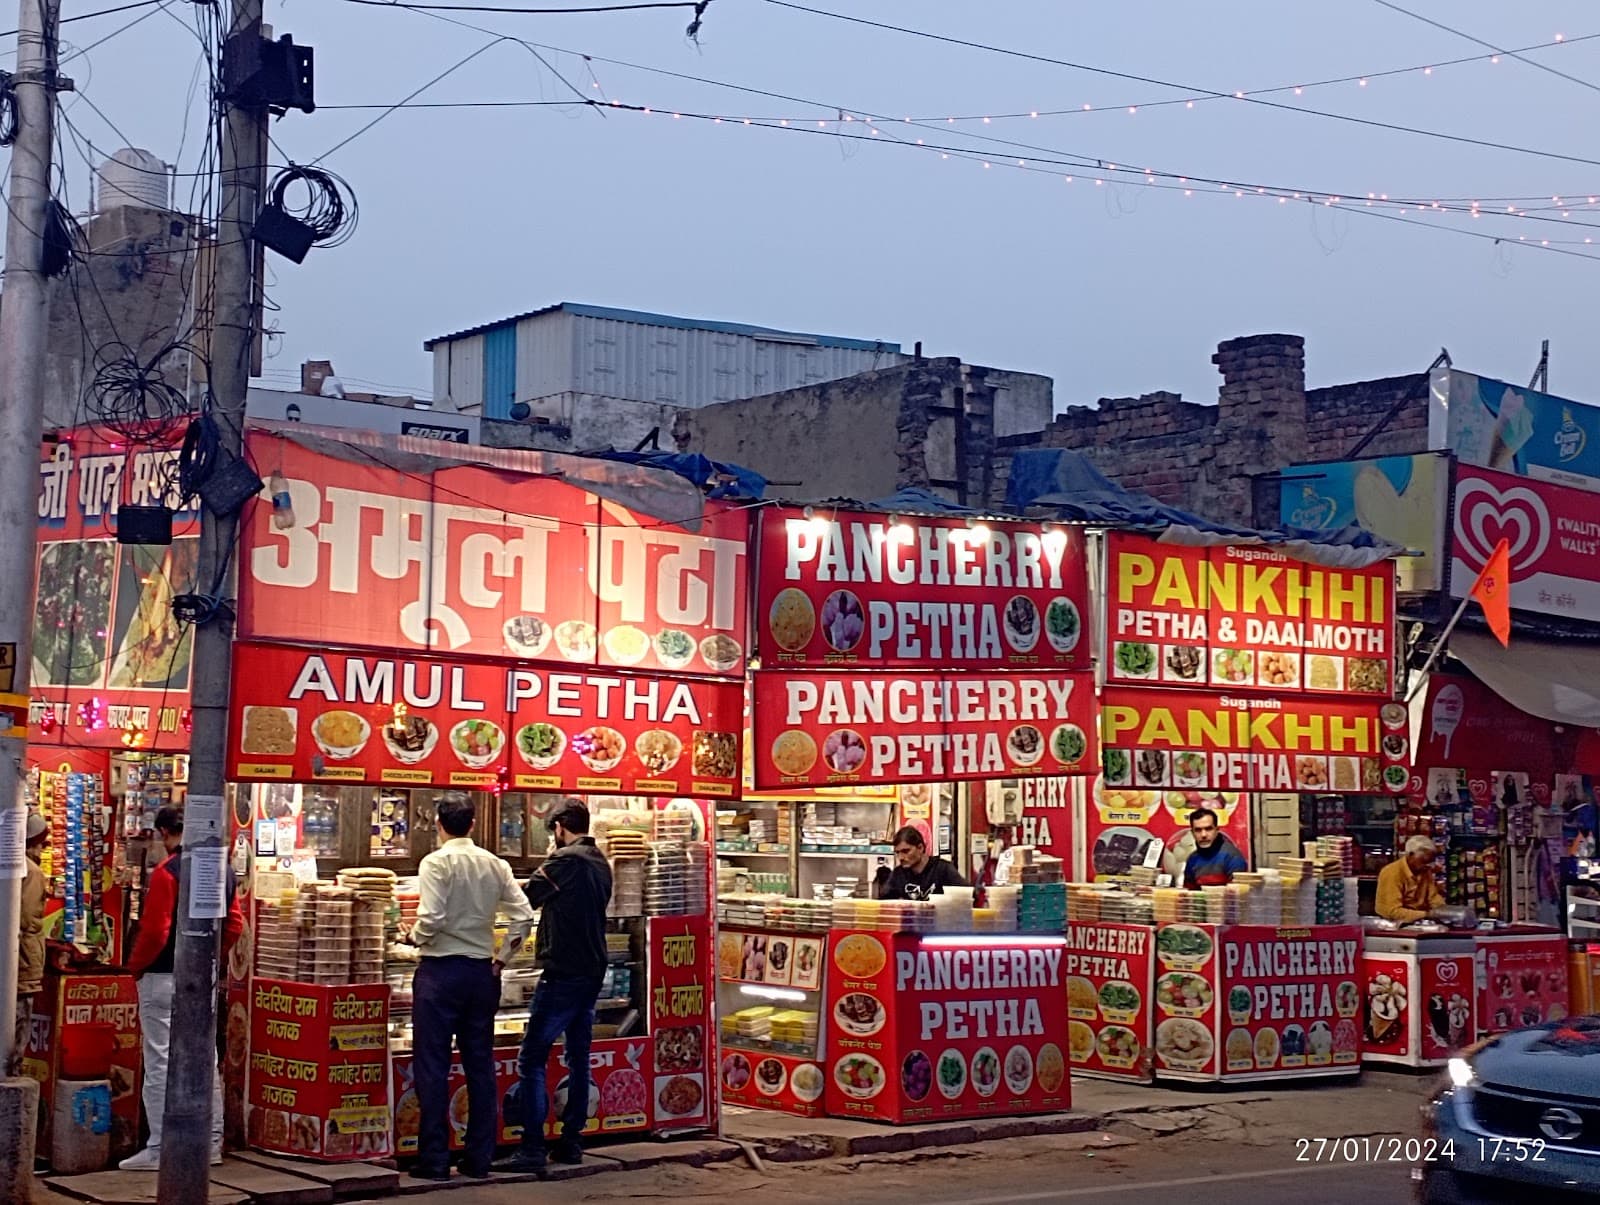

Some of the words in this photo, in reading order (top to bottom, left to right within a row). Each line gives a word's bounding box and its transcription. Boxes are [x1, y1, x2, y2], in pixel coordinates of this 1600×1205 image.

[251, 475, 560, 650] अमूल
[583, 490, 747, 631] पेठा
[785, 518, 1068, 589] PANCHERRY
[1118, 552, 1385, 624] PANKHHI
[869, 600, 1003, 659] PETHA
[1117, 608, 1208, 641] PETHA
[1217, 616, 1238, 643] &
[1245, 618, 1385, 653] DAALMOTH
[288, 655, 486, 711] AMUL
[506, 669, 702, 725] PETHA
[785, 679, 1075, 725] PANCHERRY
[1219, 696, 1281, 710] Sugandh
[1103, 705, 1381, 754] PANKHHI
[870, 732, 1006, 777] PETHA
[1212, 752, 1293, 789] PETHA
[662, 924, 696, 968] दालमोठ
[1066, 926, 1146, 955] ANCHERRY
[896, 949, 1062, 992] PANCHERRY
[1067, 955, 1130, 979] PETHA
[1225, 941, 1357, 978] PANCHERRY
[65, 1004, 94, 1025] पान
[294, 997, 318, 1018] राम
[367, 1000, 383, 1019] राम
[920, 998, 1045, 1041] PETHA
[1254, 983, 1333, 1020] PETHA
[266, 1019, 301, 1041] गजक
[252, 1048, 285, 1079] मनोहर
[286, 1058, 319, 1082] लाल
[328, 1058, 360, 1085] मनोहर
[361, 1063, 383, 1083] लाल
[262, 1084, 297, 1107] गजक
